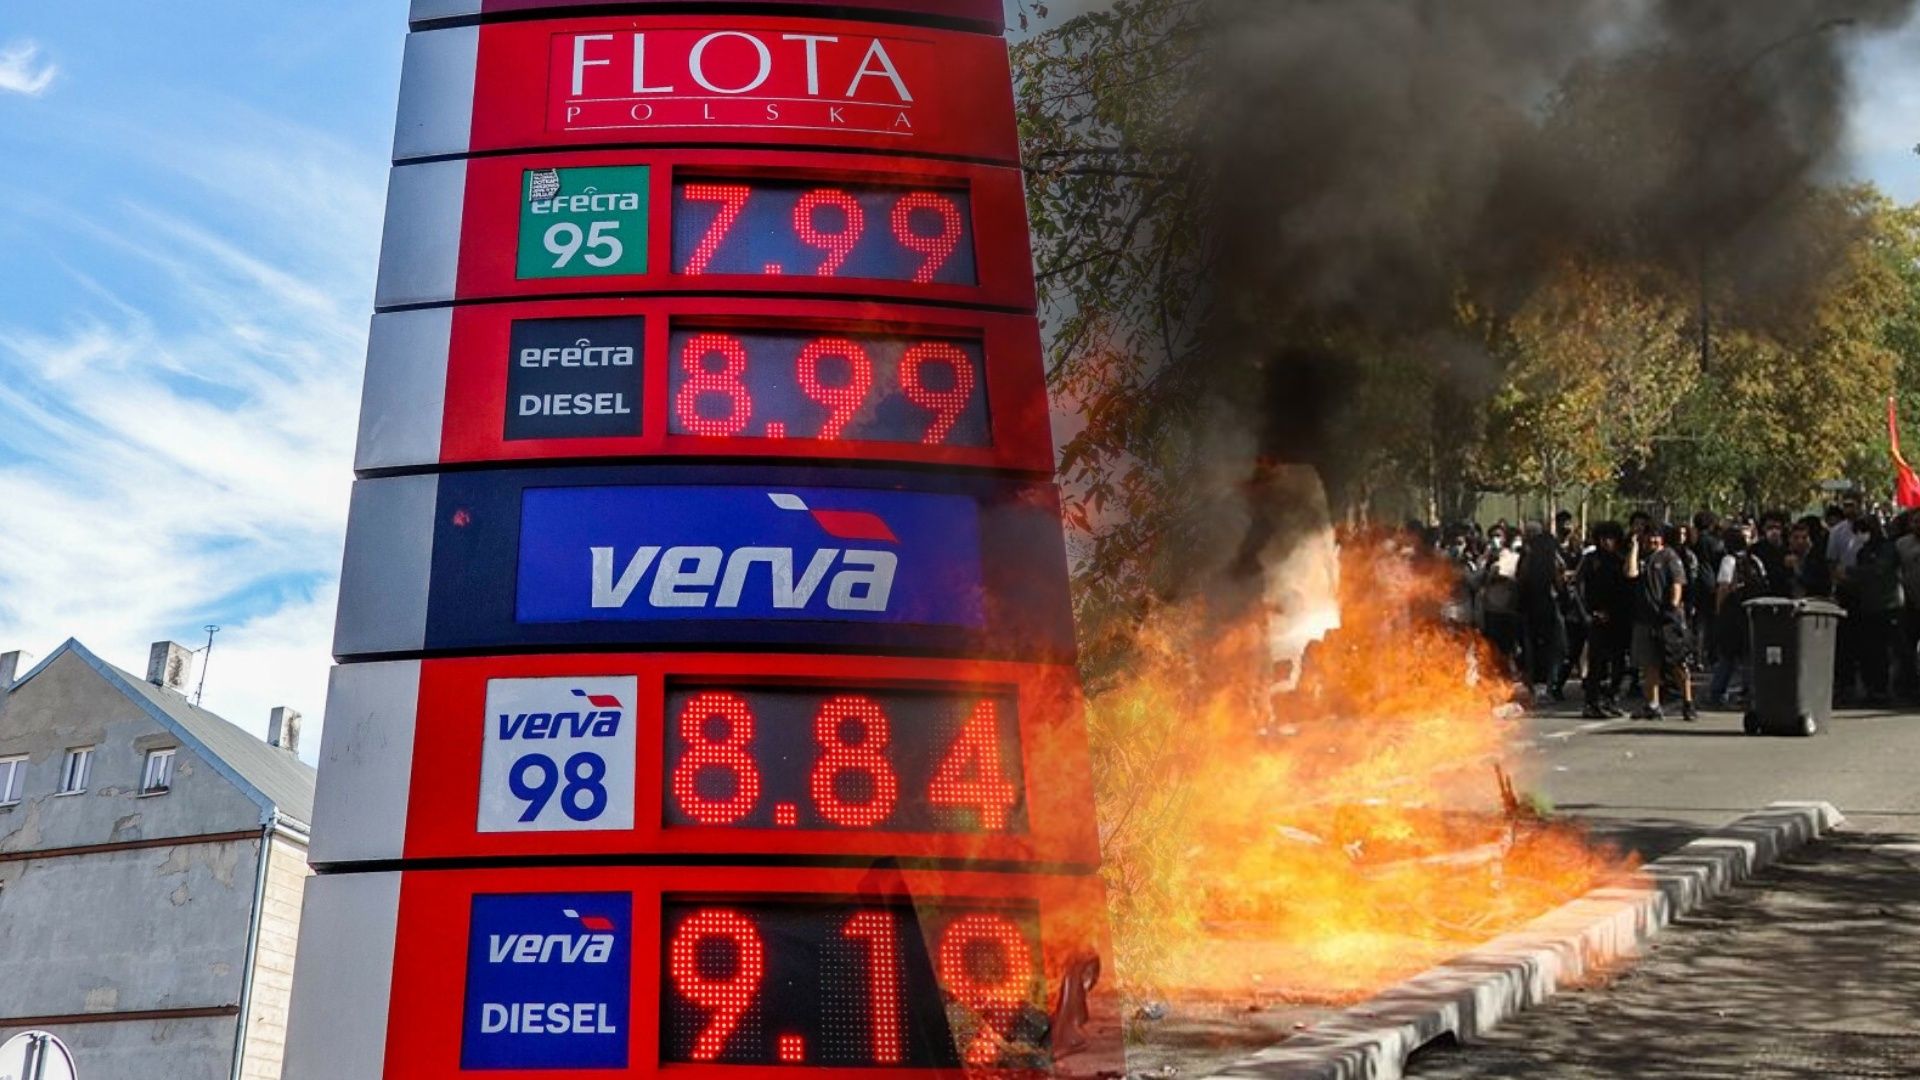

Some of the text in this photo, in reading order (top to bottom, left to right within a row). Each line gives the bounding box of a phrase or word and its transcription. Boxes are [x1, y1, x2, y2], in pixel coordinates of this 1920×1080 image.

[571, 32, 914, 101] FLOTA
[566, 103, 912, 128] POLSKA
[543, 221, 623, 268] 95
[684, 185, 961, 284] 7.99
[518, 392, 631, 418] DIESEL
[676, 334, 975, 445] 8.99
[591, 546, 899, 611] verva
[498, 707, 622, 740] verva
[508, 752, 608, 823] 98
[673, 694, 1015, 829] 8.84
[488, 929, 615, 964] verva
[480, 1002, 617, 1035] DIESEL
[672, 910, 1031, 1063] 9.19
